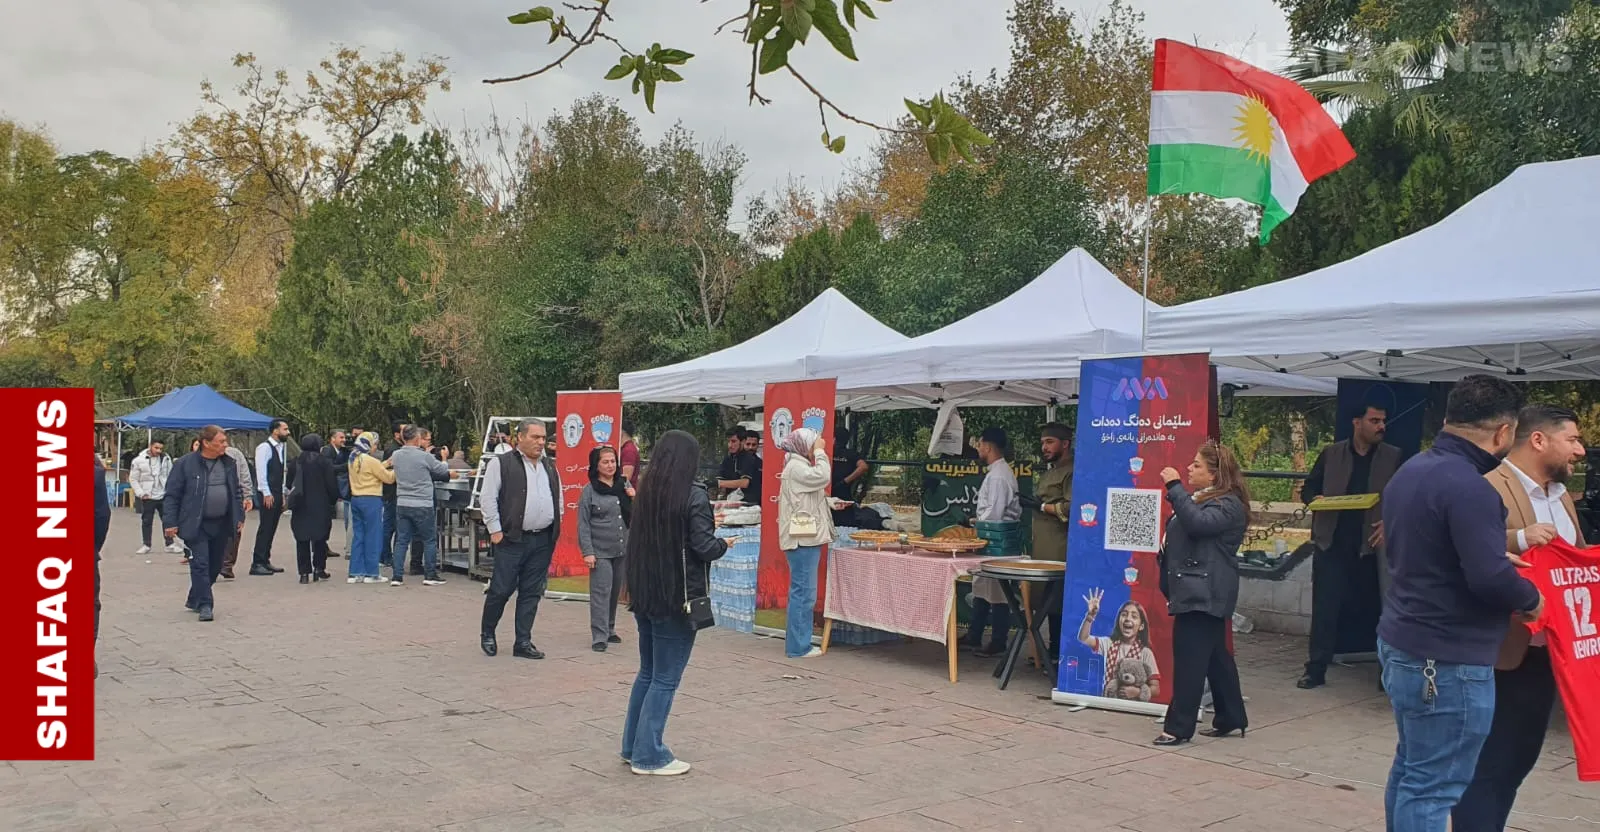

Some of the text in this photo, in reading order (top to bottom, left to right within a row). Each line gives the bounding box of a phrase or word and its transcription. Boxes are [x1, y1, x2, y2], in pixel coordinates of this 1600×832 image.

[1112, 377, 1169, 401] AVA
[1091, 413, 1192, 430] سلێمانی دەنگ دەدات
[1550, 566, 1600, 587] ULTRAS
[1564, 586, 1597, 638] 12
